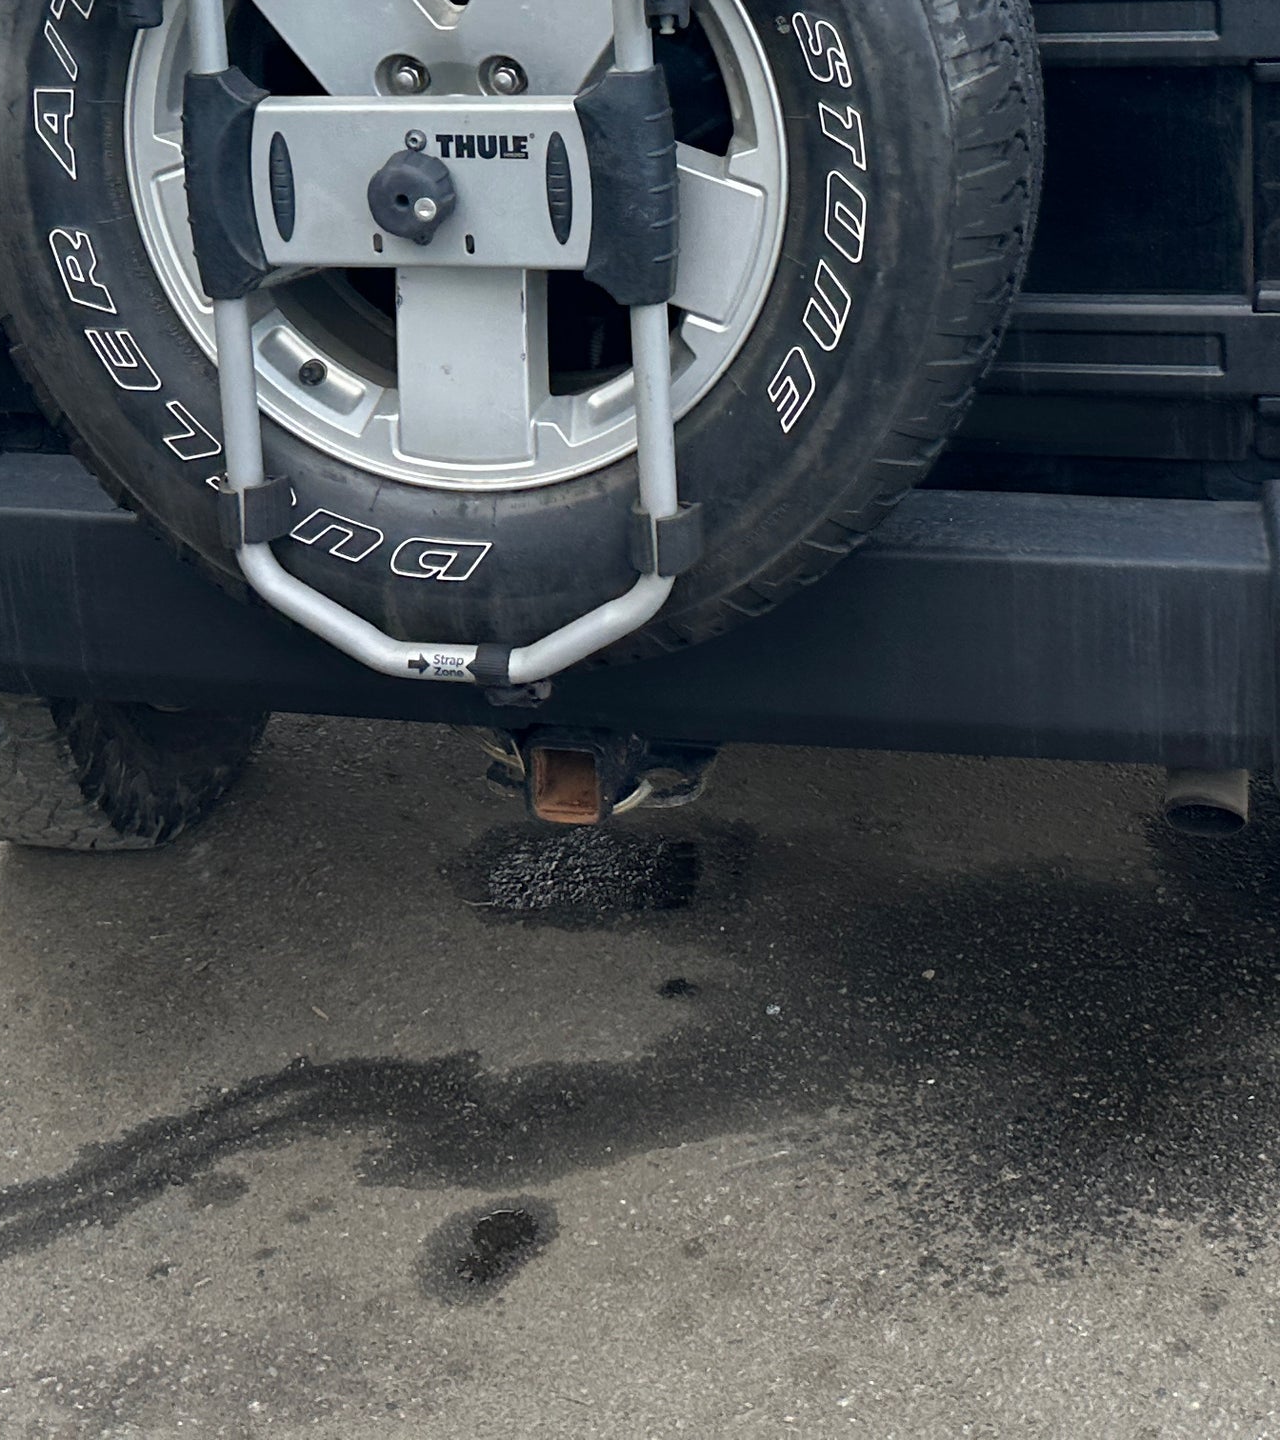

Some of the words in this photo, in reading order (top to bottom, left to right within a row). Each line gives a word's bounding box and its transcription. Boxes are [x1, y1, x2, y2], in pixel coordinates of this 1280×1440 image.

[435, 134, 529, 160] THULE
[433, 654, 464, 667] Strap
[433, 666, 465, 677] Zone
